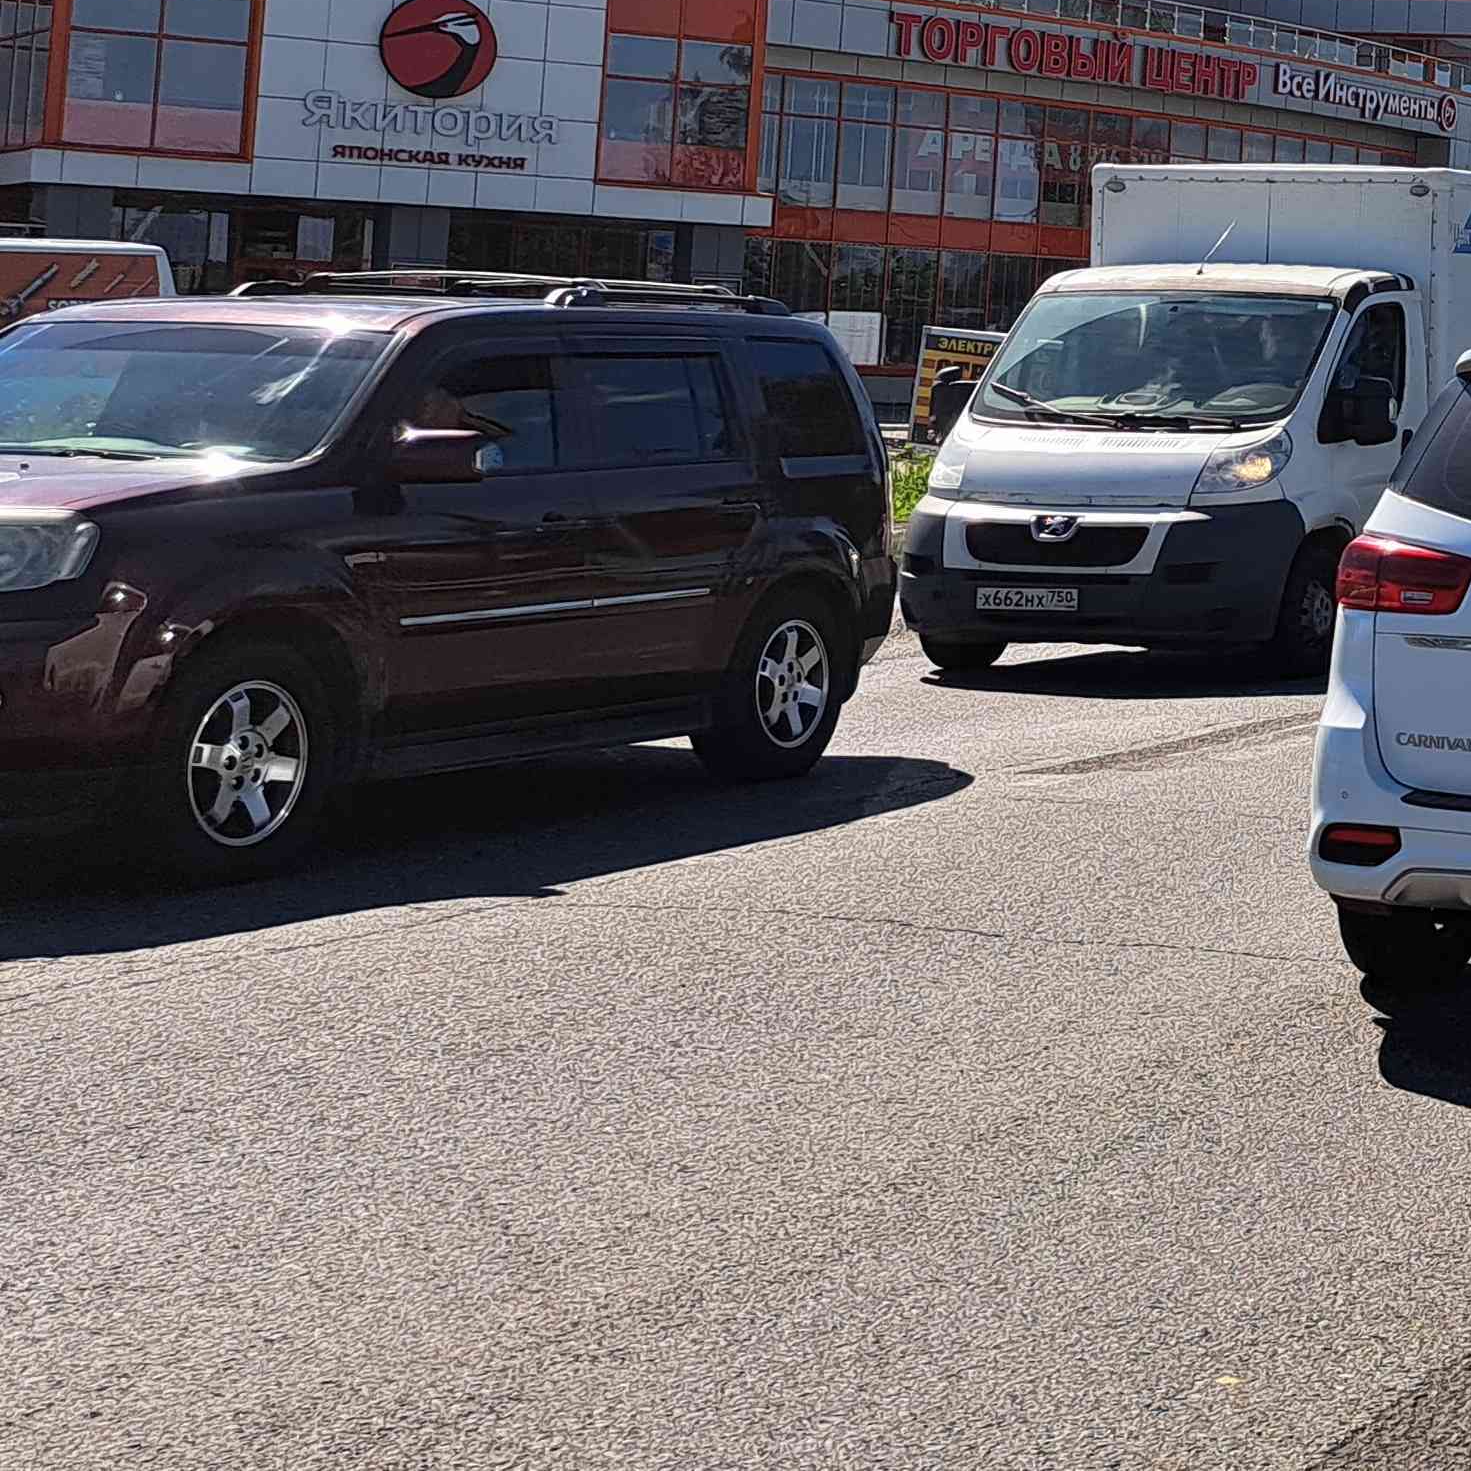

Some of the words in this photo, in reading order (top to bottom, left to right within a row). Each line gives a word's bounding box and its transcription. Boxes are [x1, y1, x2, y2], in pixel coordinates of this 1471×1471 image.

[890, 10, 1133, 86] ТОРГОВЫЙ
[1142, 48, 1258, 102] ЦЕНТР
[302, 89, 561, 147] Якитория
[331, 143, 451, 166] ЯПОНСКАЯ
[457, 152, 529, 172] КУХНЯ
